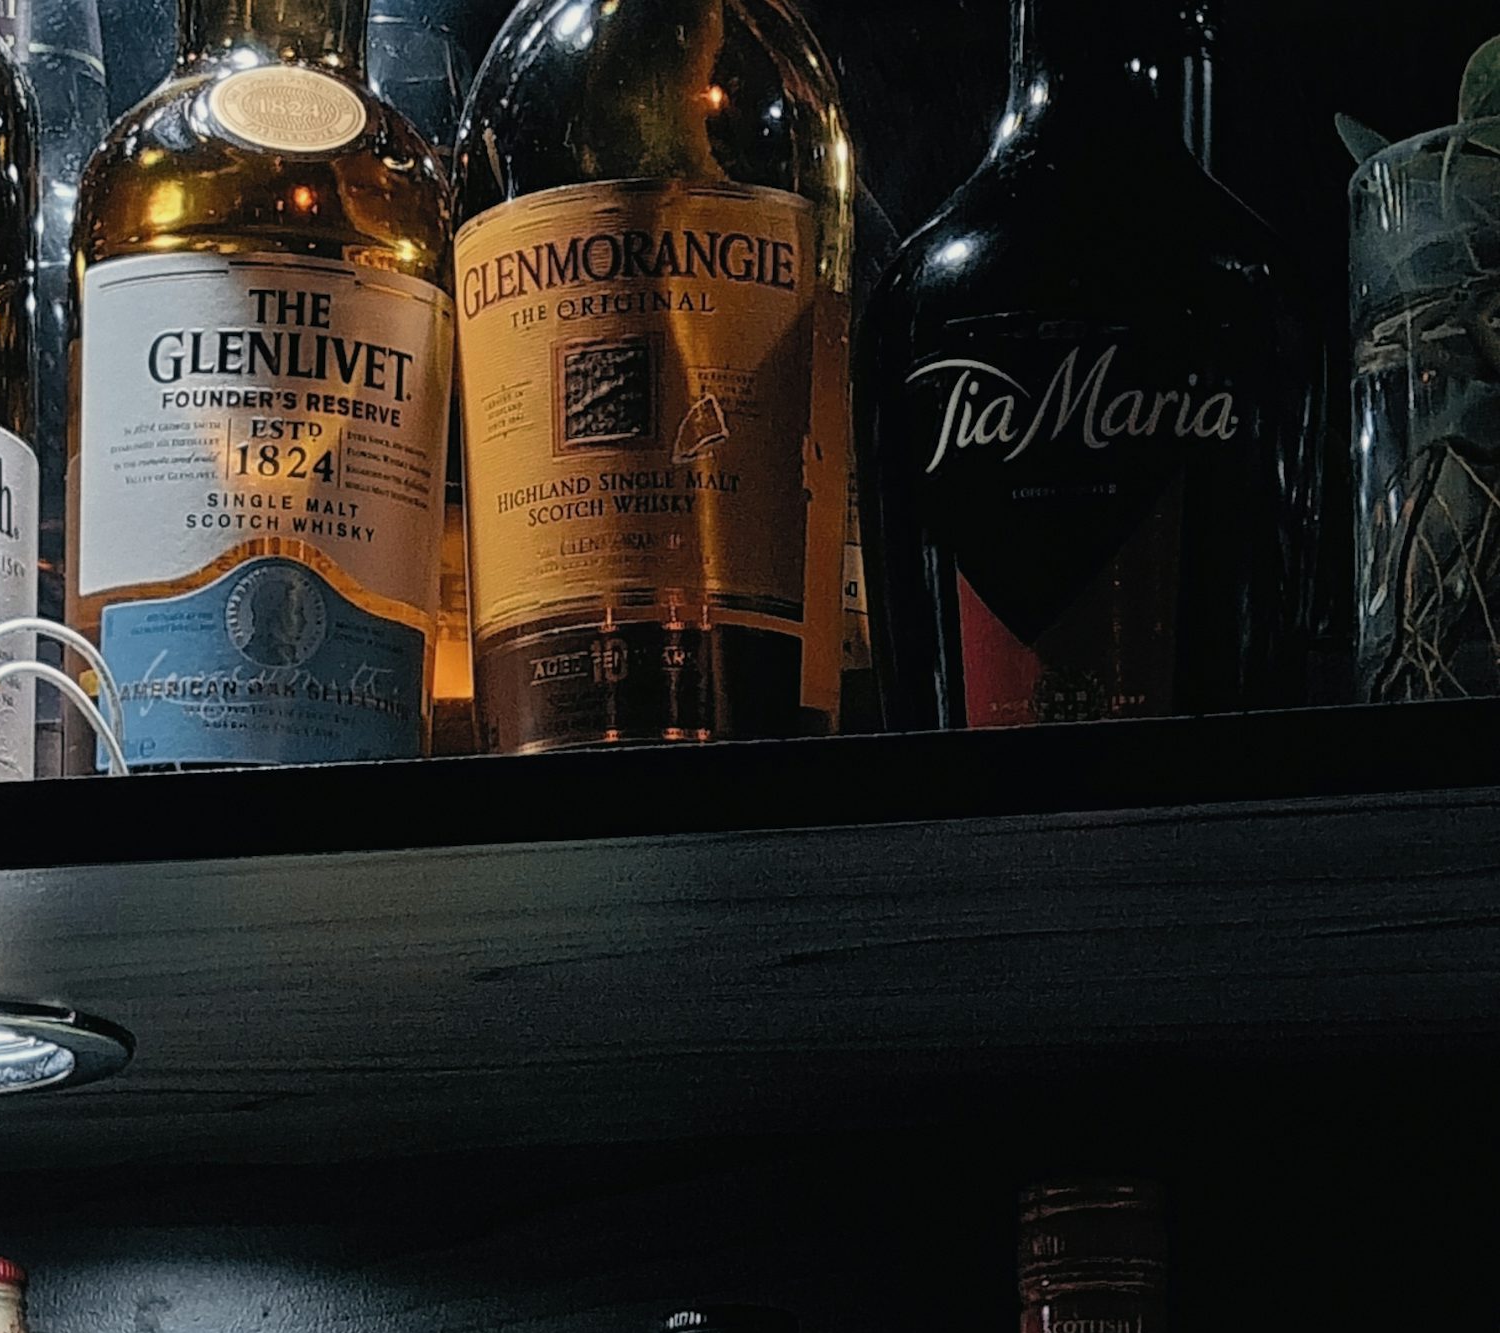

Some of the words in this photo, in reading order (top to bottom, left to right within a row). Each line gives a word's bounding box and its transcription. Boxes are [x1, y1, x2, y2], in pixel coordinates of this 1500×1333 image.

[462, 229, 797, 322] GLENMORANGIE
[248, 289, 331, 330] THE
[511, 303, 548, 329] THE
[557, 290, 717, 319] ORIGINAL
[147, 329, 411, 402] GLENLIVET
[161, 390, 298, 413] FOUNDER'S
[306, 393, 402, 428] RESERVE
[904, 358, 1032, 474] Tia
[1002, 344, 1238, 463] Maria
[234, 444, 335, 483] 1824
[207, 493, 293, 511] SINGLE
[306, 500, 360, 519] MALT
[497, 476, 591, 514] HIGHLAND
[599, 471, 675, 491] SINGLE
[686, 470, 741, 495] MALT
[527, 497, 604, 528] SCOTCH
[613, 494, 696, 514] WHISKY
[186, 513, 280, 532] SCOTCH
[292, 517, 375, 542] WHISKY
[119, 679, 238, 701] AMERICAN
